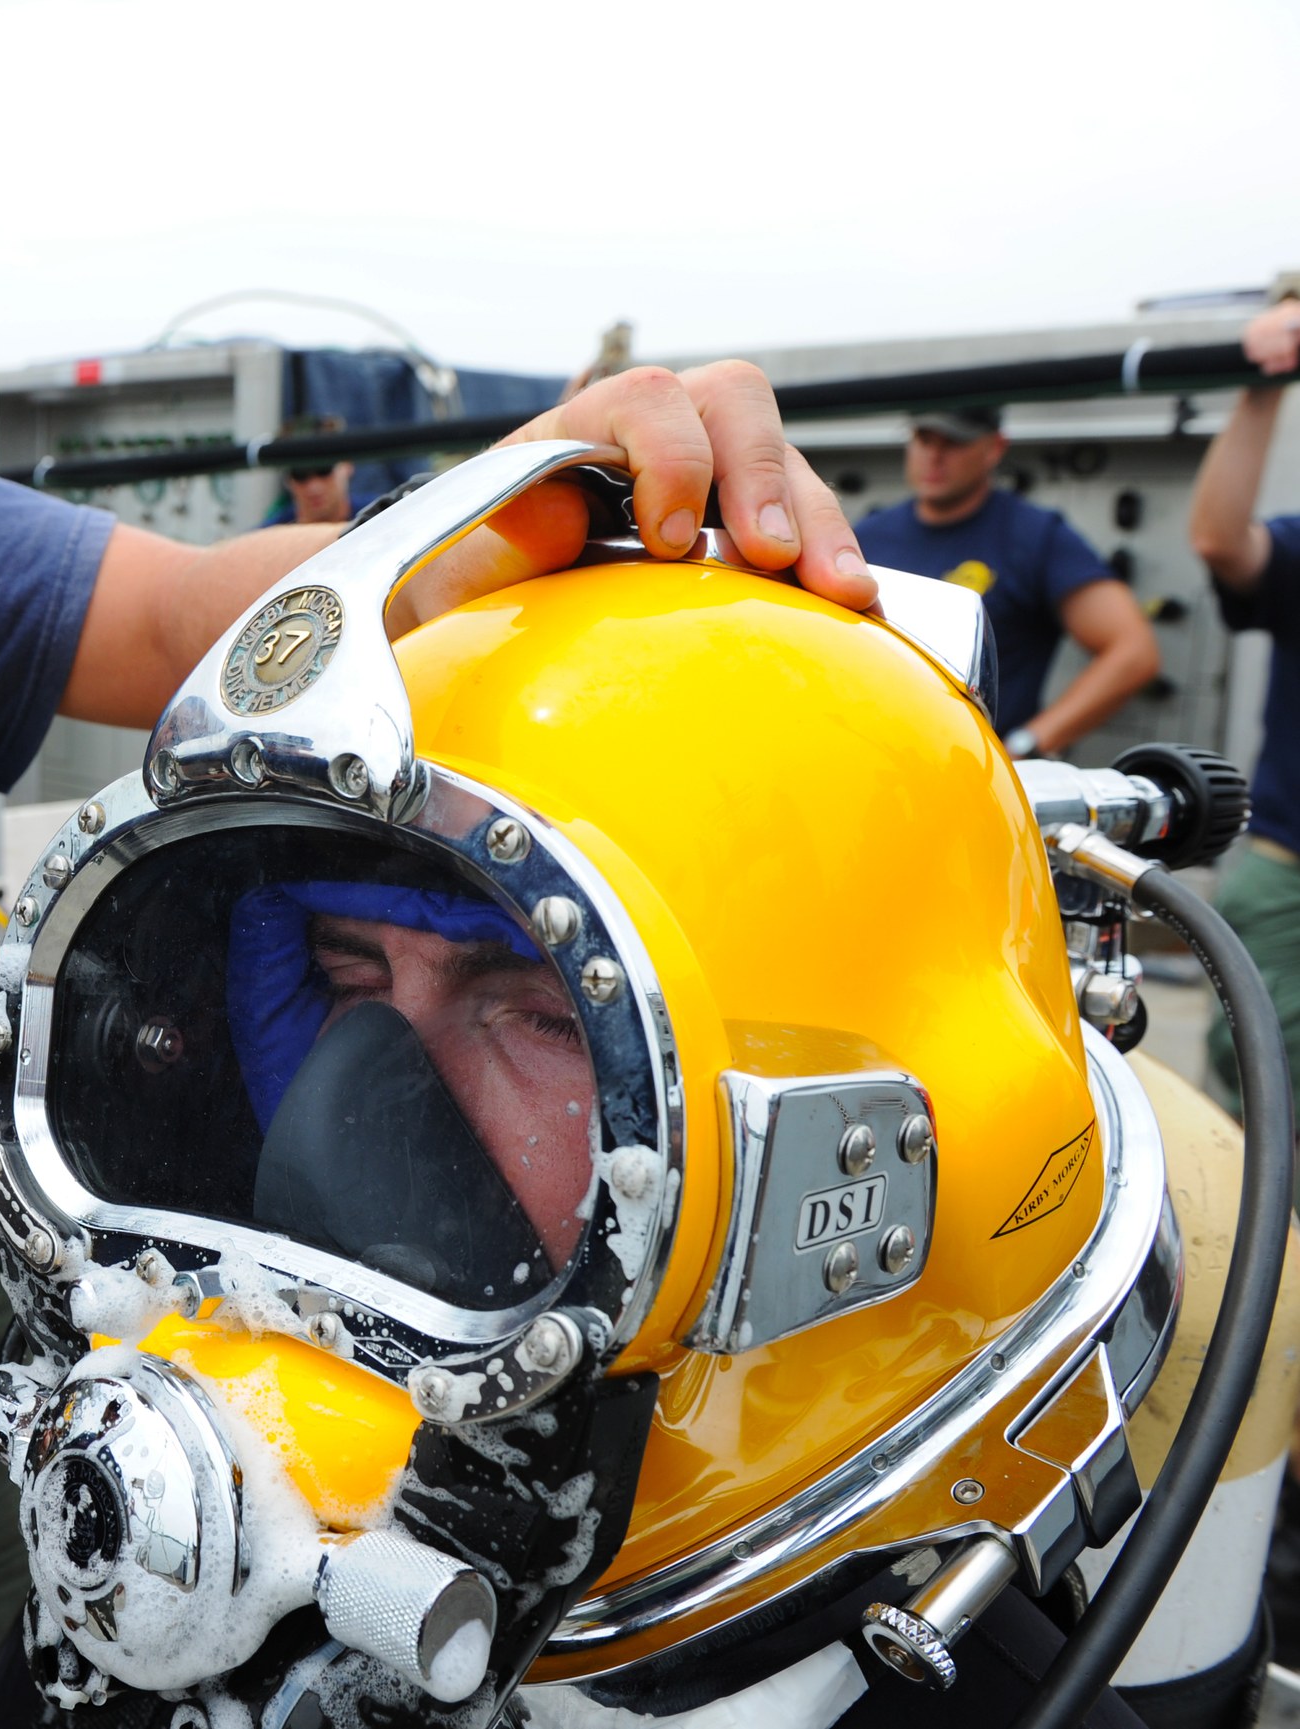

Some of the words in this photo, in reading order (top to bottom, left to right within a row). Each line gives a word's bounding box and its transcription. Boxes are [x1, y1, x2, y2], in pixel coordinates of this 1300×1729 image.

[238, 598, 288, 648] KIRBY
[298, 591, 341, 647] MORGAN
[255, 630, 311, 664] 37
[1014, 1185, 1050, 1224] KIRBY
[1052, 1134, 1089, 1189] MORGAN
[804, 1185, 877, 1241] DSI
